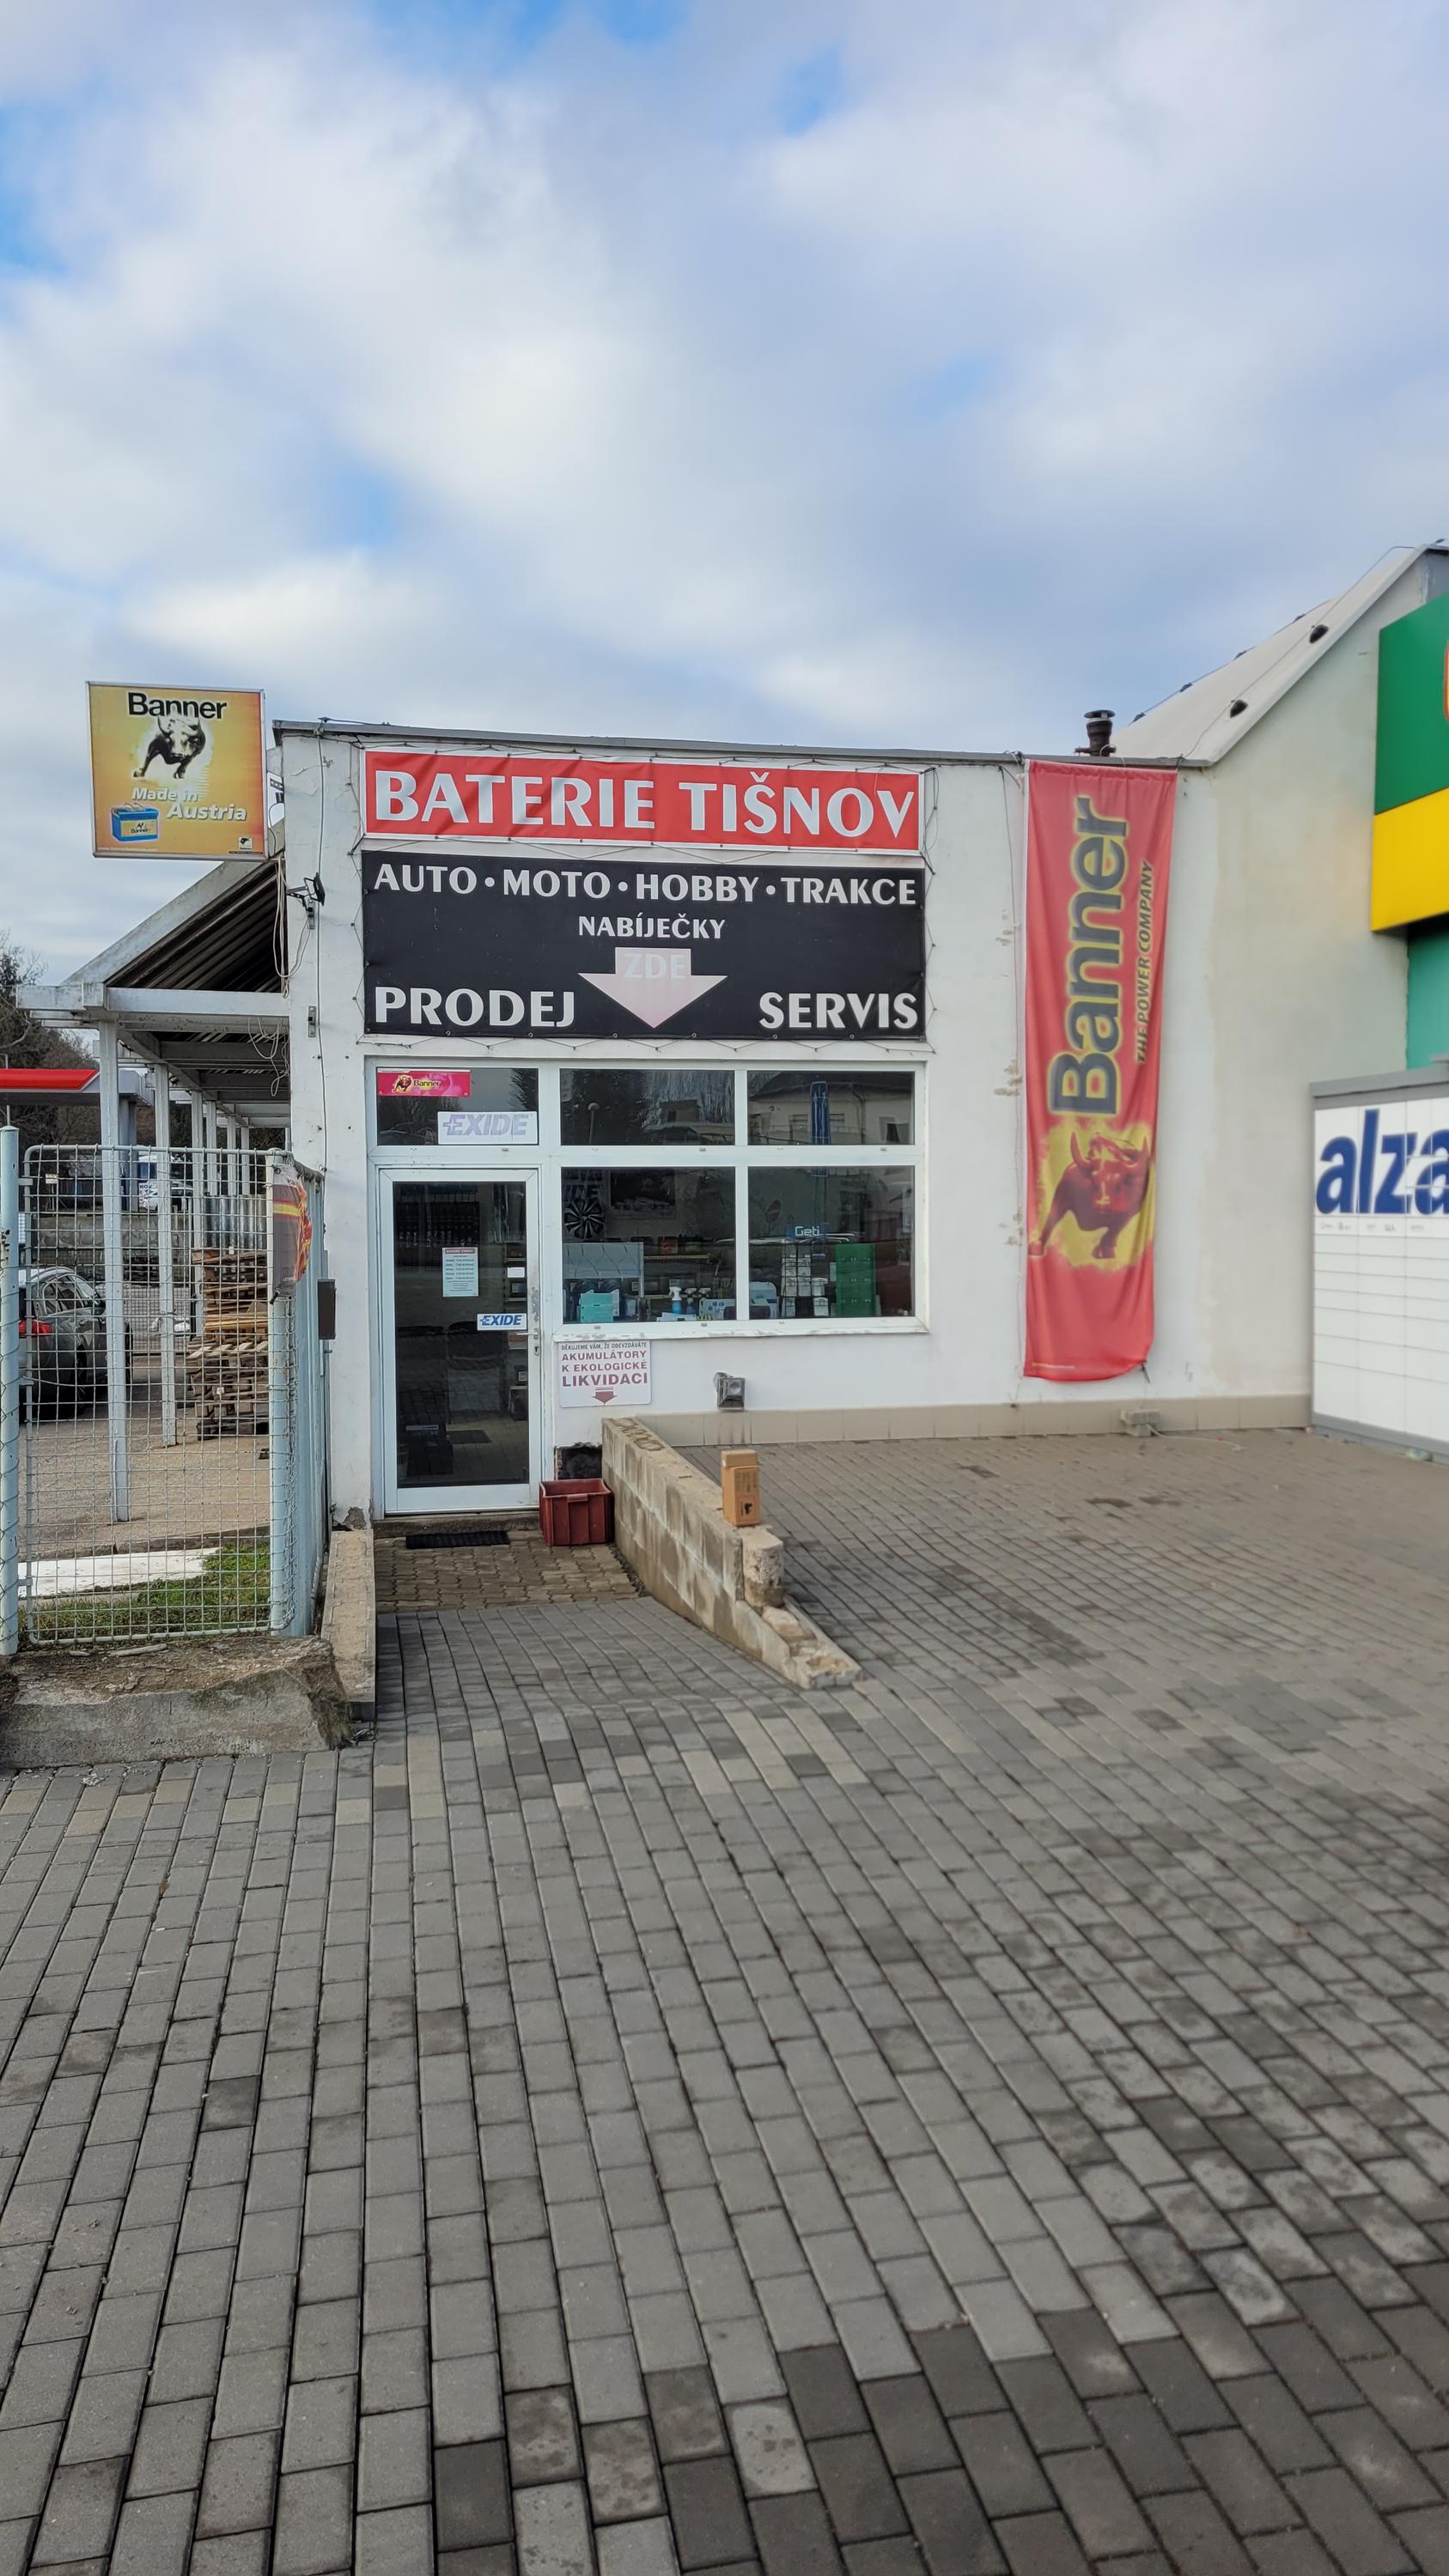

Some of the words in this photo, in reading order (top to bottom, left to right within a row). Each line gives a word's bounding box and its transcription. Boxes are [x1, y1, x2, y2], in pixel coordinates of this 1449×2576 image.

[128, 692, 227, 720] Banner
[132, 787, 178, 802] Made
[183, 789, 199, 803] in
[375, 770, 655, 829] BATERIE
[679, 771, 915, 838] TIŠNOV
[166, 802, 247, 821] Austria
[374, 862, 478, 895] AUTO
[503, 868, 612, 900] MOTO
[636, 872, 759, 903] HOBBY
[781, 877, 916, 905] TRAKCE
[1138, 861, 1154, 953] COMPANY
[578, 912, 726, 940] NABÍJEČKY
[624, 952, 685, 981] ZDE
[1050, 796, 1128, 1115] Banner
[1137, 957, 1151, 1025] POWER
[374, 987, 575, 1029] PRODEJ
[759, 991, 918, 1030] SERVIS
[1136, 1027, 1148, 1064] THE
[413, 1079, 441, 1088] Banner
[443, 1114, 530, 1137] EXIDE
[1316, 1109, 1449, 1215] alza
[795, 1225, 820, 1236] Geti
[480, 1315, 522, 1327] EXIDE
[562, 1349, 647, 1361] AKUMULÁTORY
[562, 1364, 569, 1373] K
[574, 1359, 648, 1372] EKOLOGICKÉ
[563, 1372, 648, 1387] LIKVIDACI
